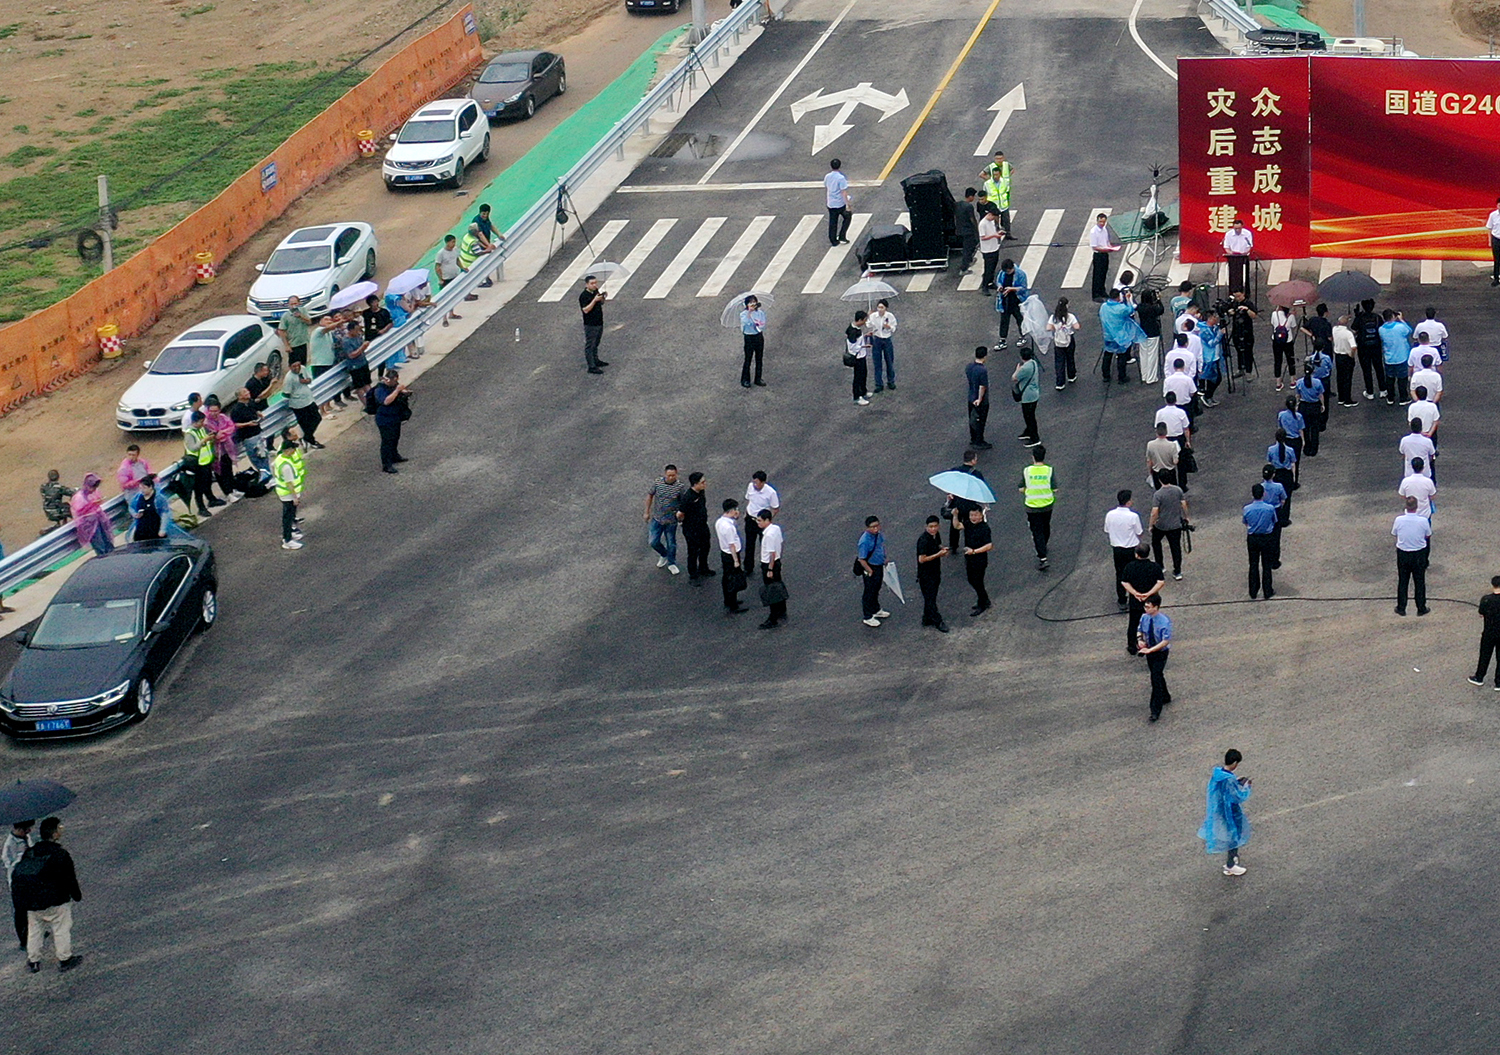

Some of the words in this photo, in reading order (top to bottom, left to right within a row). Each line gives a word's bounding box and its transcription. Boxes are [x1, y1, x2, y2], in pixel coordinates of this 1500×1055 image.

[1206, 87, 1238, 234] 灾后重建
[1250, 86, 1283, 233] 众志成城
